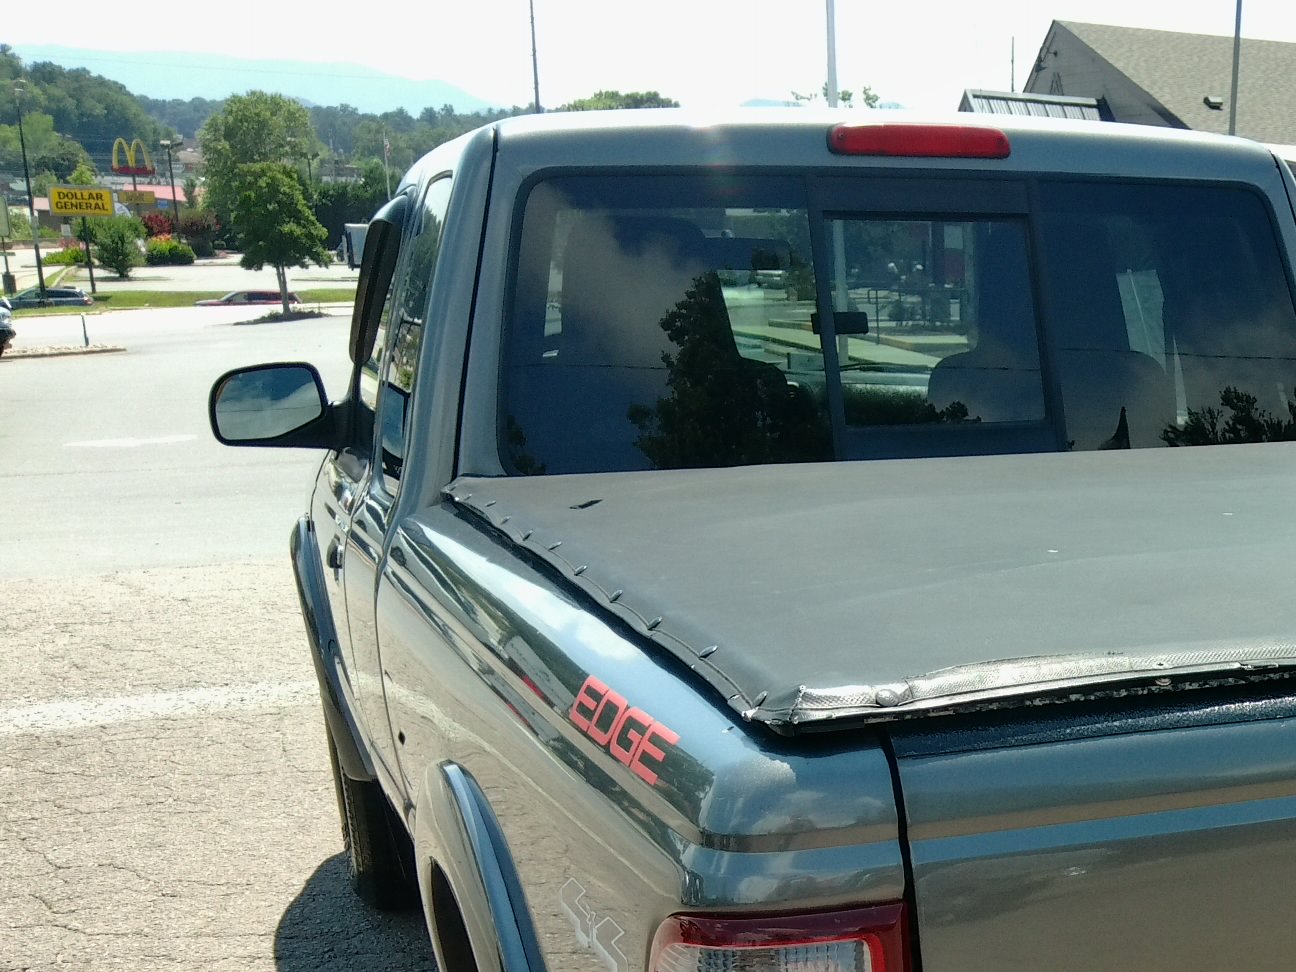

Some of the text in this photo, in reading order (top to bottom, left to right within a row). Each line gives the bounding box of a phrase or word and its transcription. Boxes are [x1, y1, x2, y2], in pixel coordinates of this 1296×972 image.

[57, 191, 104, 201] DOLLAR
[56, 201, 108, 211] GENERAL
[568, 674, 681, 785] EDGE
